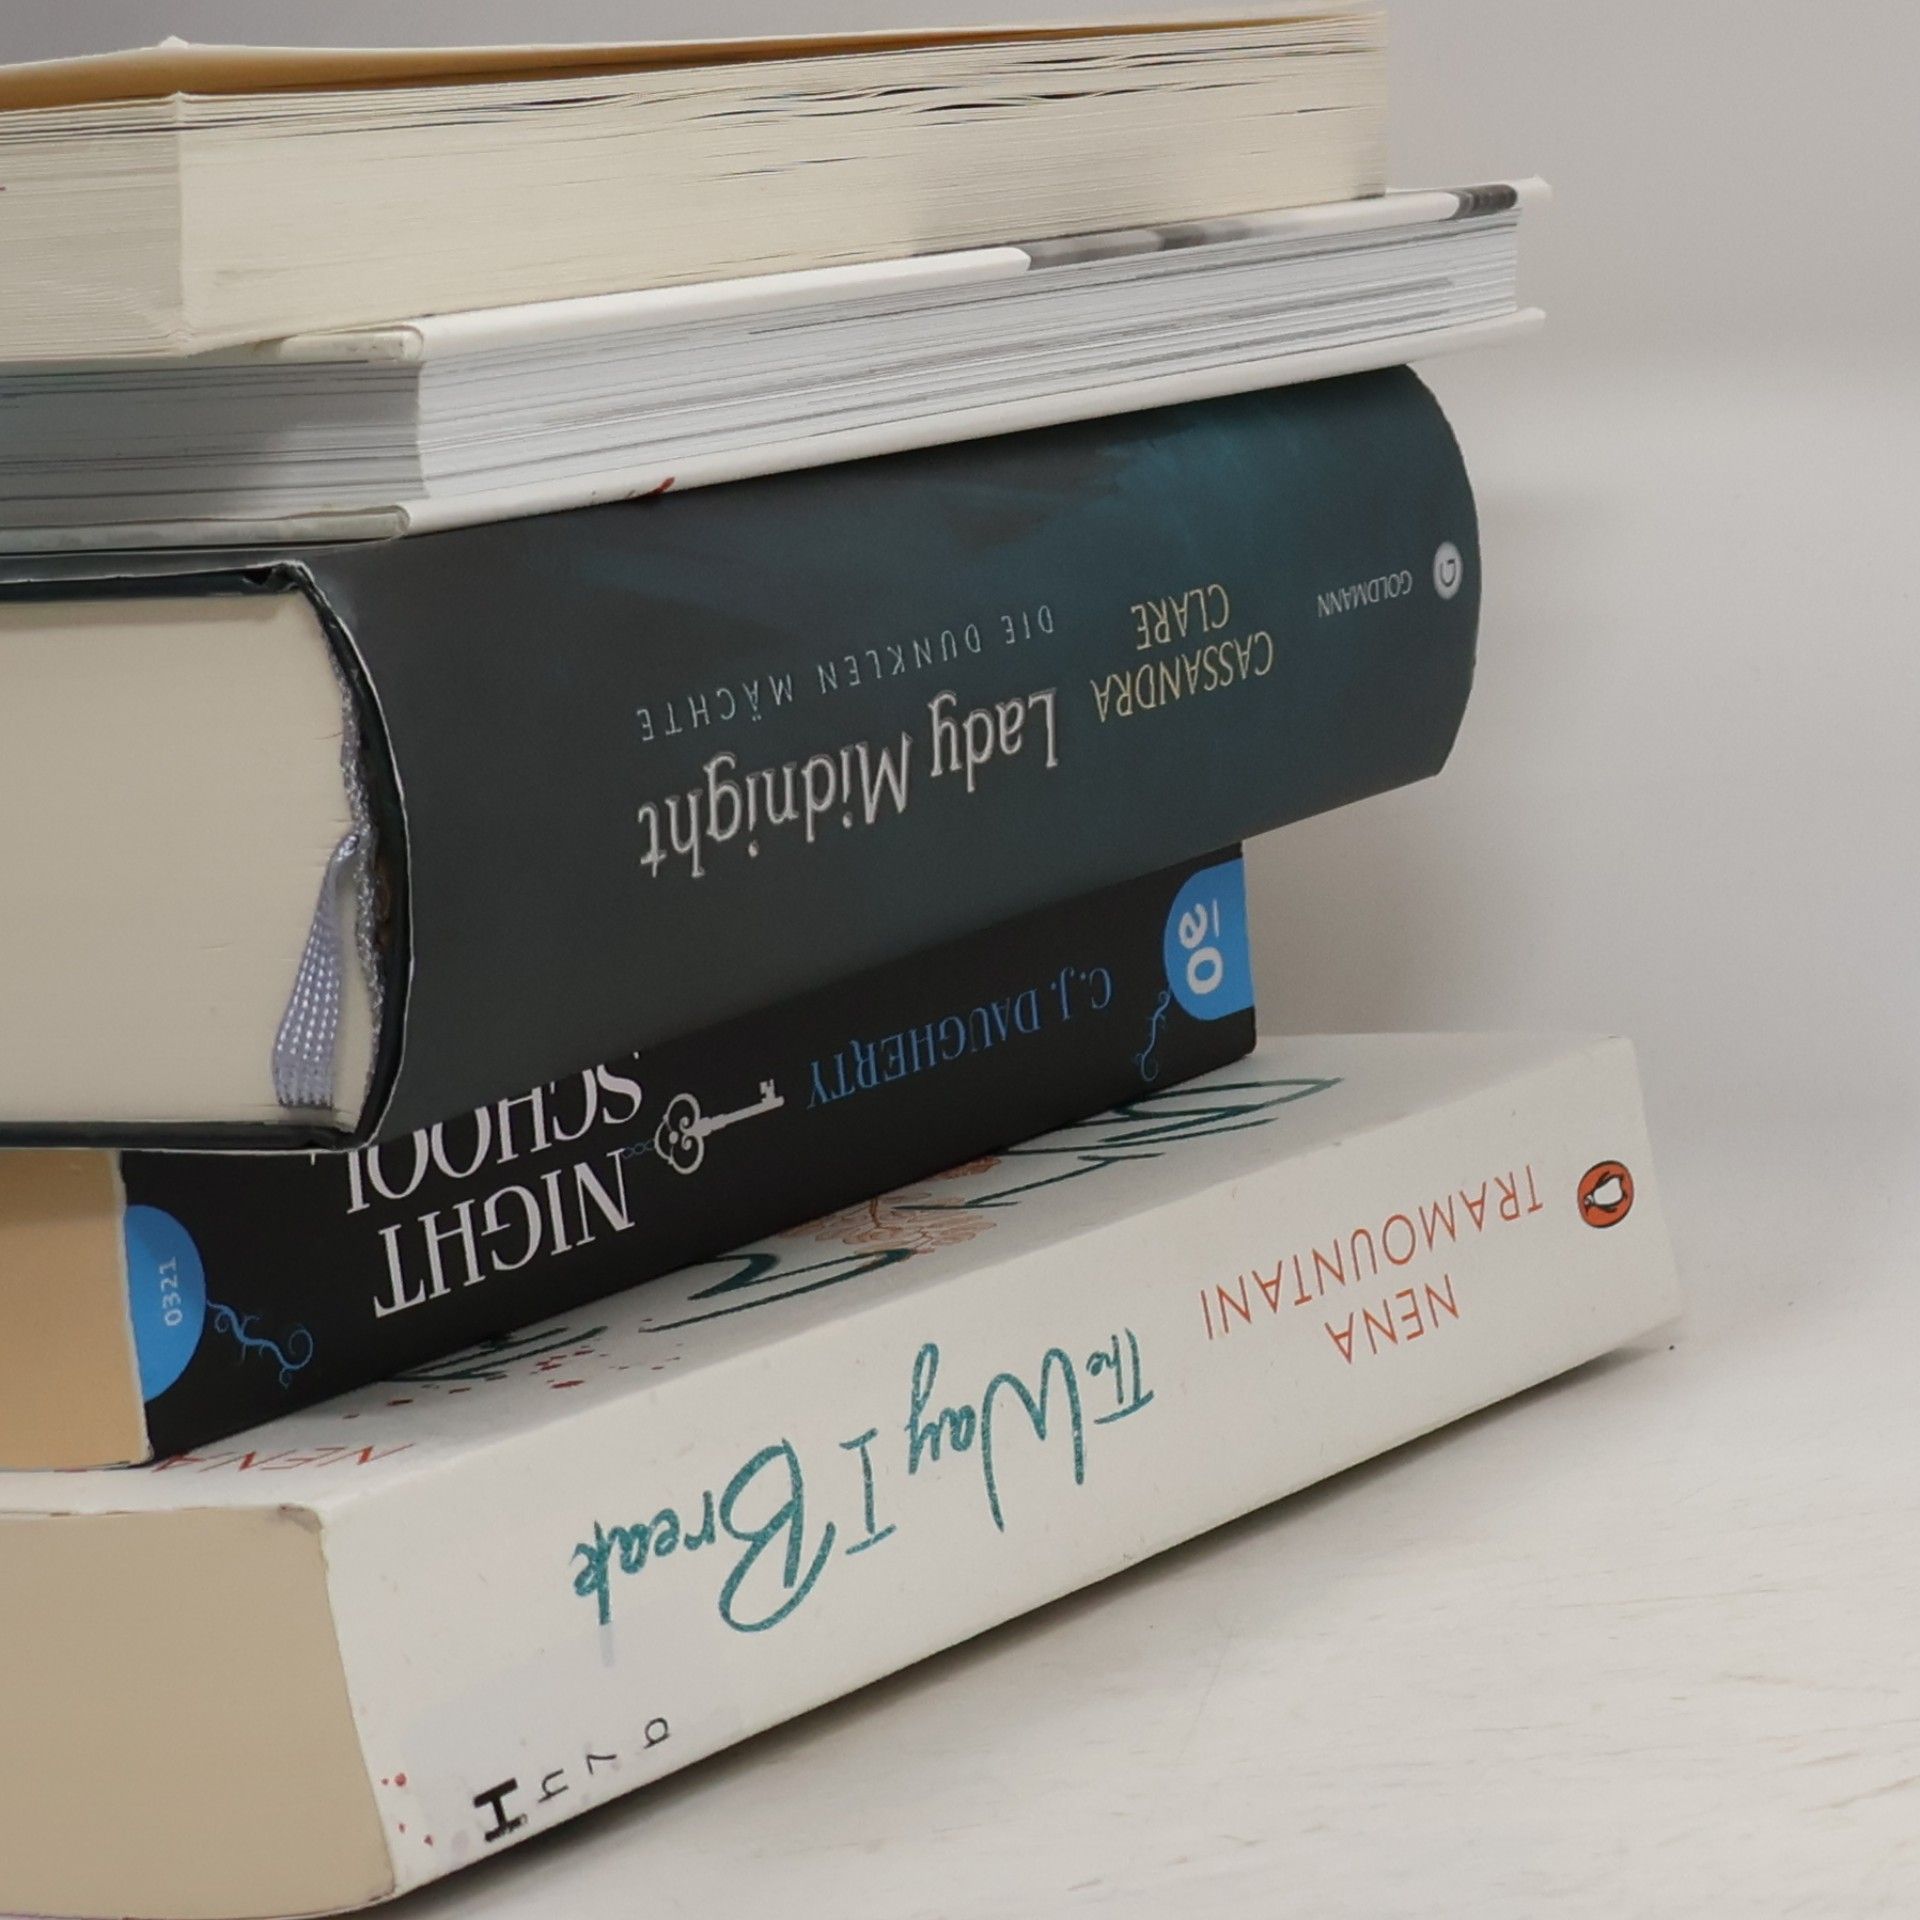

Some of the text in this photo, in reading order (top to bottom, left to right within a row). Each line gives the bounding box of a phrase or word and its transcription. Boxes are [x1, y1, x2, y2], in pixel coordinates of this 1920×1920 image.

[1130, 583, 1231, 651] CLARE
[1317, 569, 1413, 618] GOLDMANN
[636, 604, 1055, 741] DIE DUNKLEN MÄCHTE
[1089, 630, 1275, 723] CASSANDRA
[637, 688, 1058, 878] Lady Midnight
[806, 988, 1042, 1111] DAUGHERTY
[159, 1256, 183, 1327] 0321
[373, 1147, 636, 1318] NIGHT
[1200, 1164, 1544, 1341] TRAMOUNTANI
[1324, 1272, 1461, 1365] NENA
[570, 1327, 1155, 1633] The Way I Break
